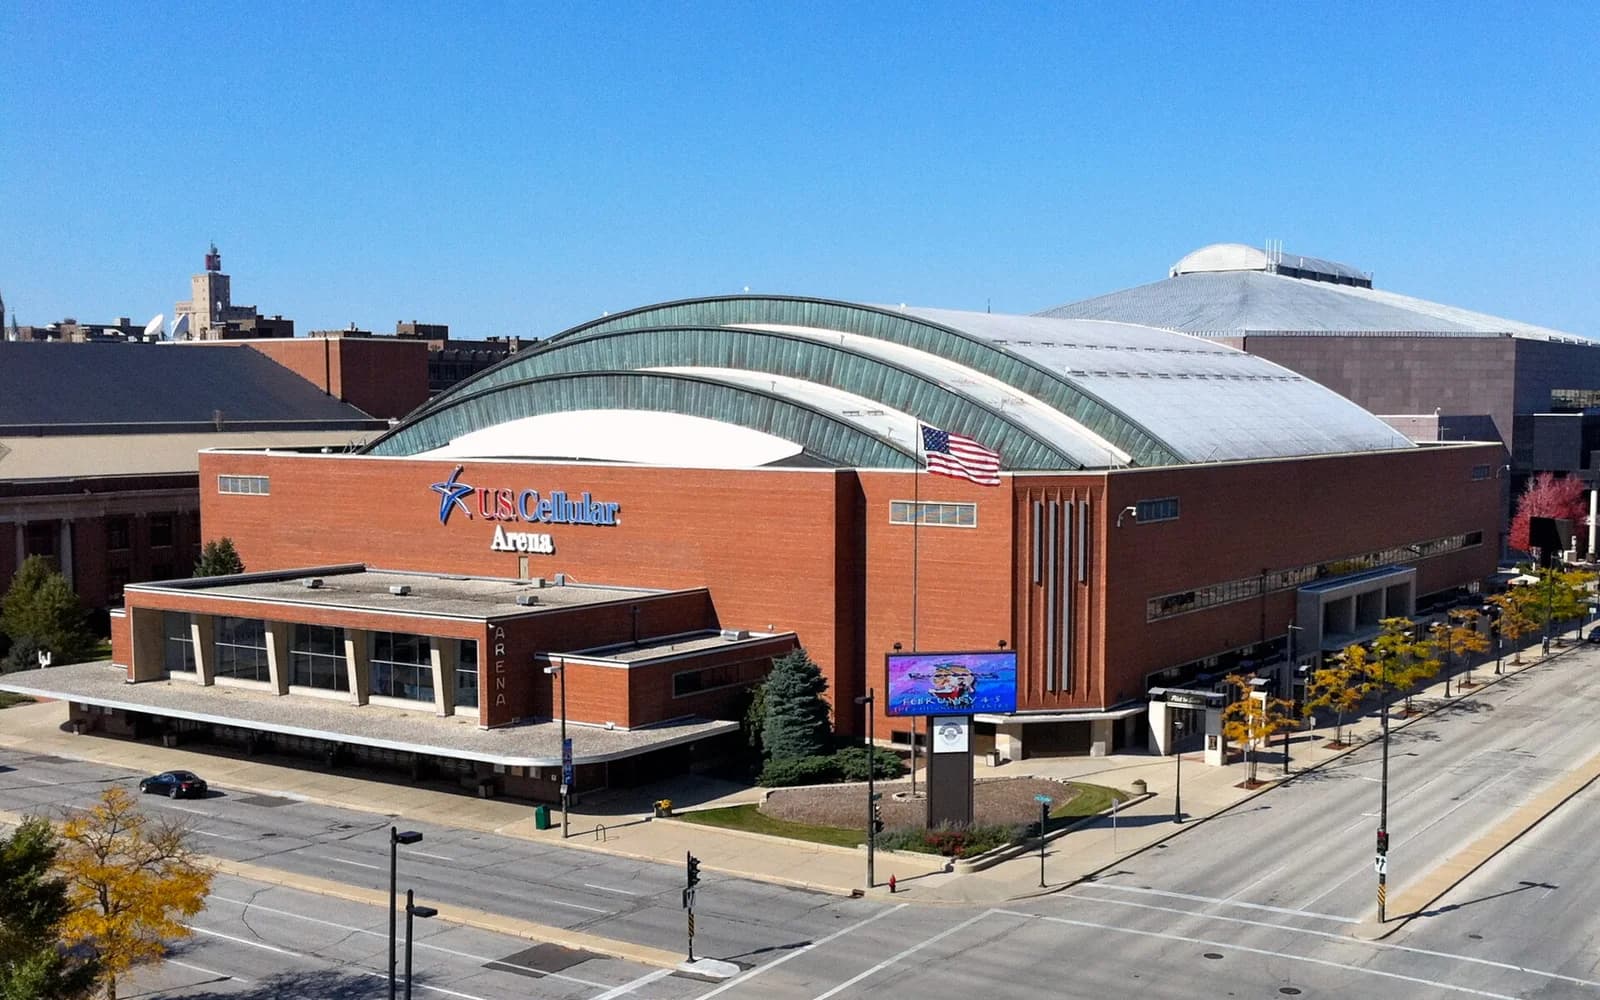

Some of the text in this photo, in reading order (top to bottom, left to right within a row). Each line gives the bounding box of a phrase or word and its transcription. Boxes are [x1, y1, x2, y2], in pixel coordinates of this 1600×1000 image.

[490, 524, 555, 554] Arena
[494, 626, 506, 707] ARENA
[902, 696, 977, 707] FEBRUY
